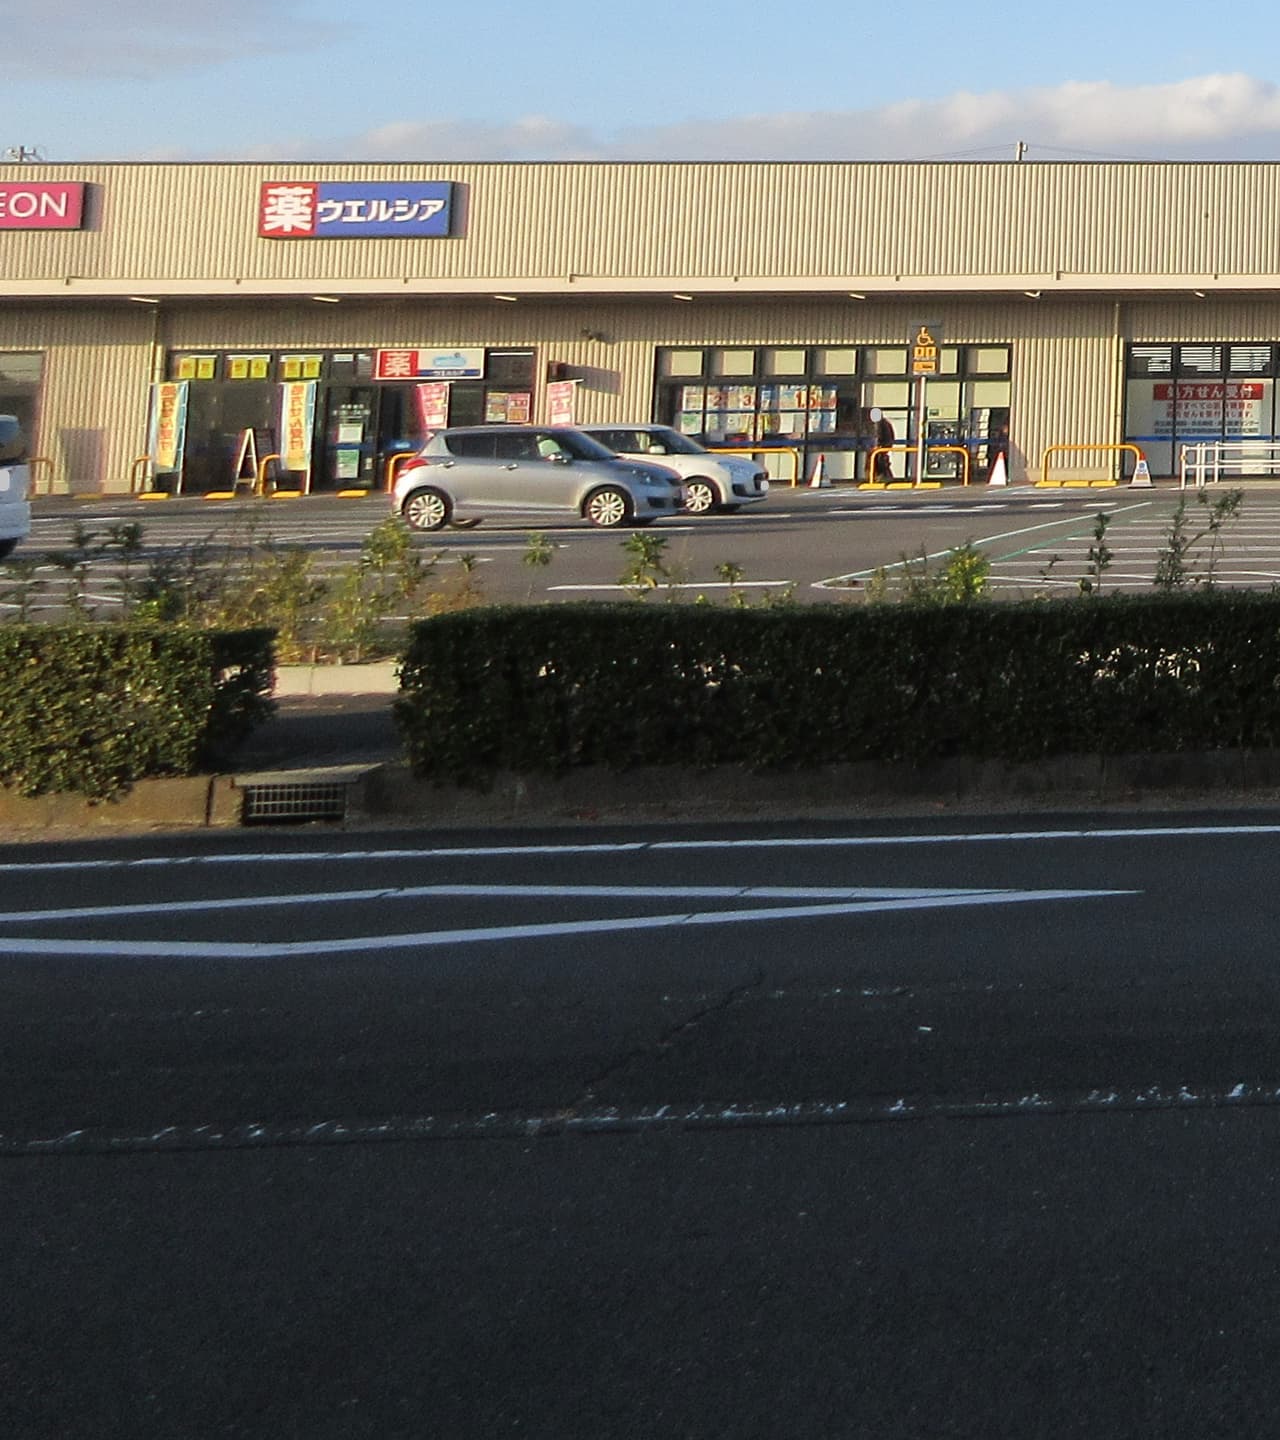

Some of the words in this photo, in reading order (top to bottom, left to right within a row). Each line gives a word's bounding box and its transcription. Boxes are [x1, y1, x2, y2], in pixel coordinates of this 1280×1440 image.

[264, 186, 313, 232] 薬
[317, 199, 445, 223] ウエルシア
[384, 352, 413, 376] 薬
[1167, 385, 1253, 398] 処方せん受付
